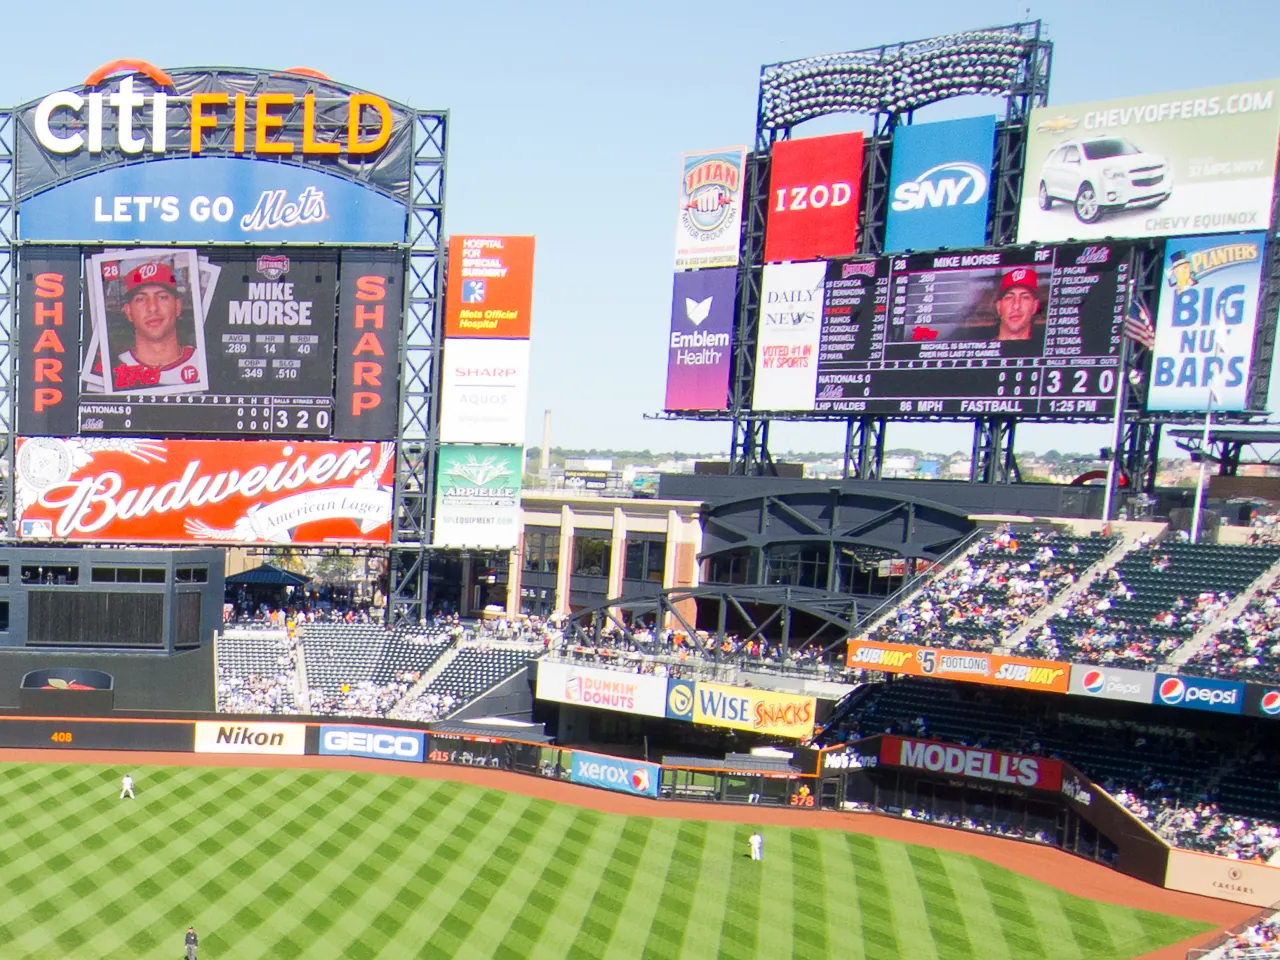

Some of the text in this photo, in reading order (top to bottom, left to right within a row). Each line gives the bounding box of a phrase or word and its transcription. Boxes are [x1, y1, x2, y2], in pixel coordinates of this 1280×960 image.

[1083, 89, 1274, 130] CHEVYOFFERS.COM
[190, 92, 393, 154] FIELD
[687, 164, 736, 189] TITAN
[775, 182, 852, 211] IZOD
[891, 175, 973, 211] SNY
[94, 186, 328, 231] LET'S GO Mets
[1144, 211, 1258, 232] CHEVY EQUINOX
[462, 249, 480, 257] FOR
[463, 239, 504, 249] HOSPITAL
[933, 250, 1051, 268] MIKE MORSE RF
[1191, 245, 1258, 272] PLANTERS
[103, 266, 118, 276] 28
[248, 282, 294, 300] MIKE
[768, 289, 815, 303] DAILY
[228, 301, 313, 325] MORSE
[485, 310, 518, 319] Official
[1171, 284, 1246, 327] BIG
[459, 320, 498, 329] Hospital
[765, 311, 815, 325] NEWS
[33, 272, 65, 411] SHARP
[352, 276, 387, 415] SHARP
[670, 330, 729, 348] Emblem
[1179, 329, 1231, 353] NU
[225, 344, 247, 354] .289
[264, 344, 276, 354] 14
[298, 344, 311, 354] 40
[676, 348, 718, 365] Health
[762, 345, 812, 357] VOTED #1 IN
[763, 356, 808, 369] NY SPORTS
[183, 368, 195, 379] IF
[275, 369, 297, 379] .510
[455, 367, 516, 377] SHARP
[1046, 370, 1113, 393] 3 2 0
[459, 394, 508, 405] AQUOS
[832, 401, 1096, 412] VALDES 86 MPH FASTBALL 1:25 PM
[81, 406, 124, 414] NATIONALS
[276, 410, 329, 428] 3 2 0
[41, 446, 372, 537] Budweiser
[444, 487, 514, 498] ARPIELLE
[266, 497, 384, 530] American Lager
[852, 647, 1063, 685] SUBWAY $5 FOOTLONG SUBWAY
[585, 680, 638, 696] DUNKIN'
[1107, 682, 1140, 694] pepsi
[1186, 687, 1238, 705] pepsi
[583, 691, 634, 709] DONUTS
[699, 689, 811, 728] WISE SNACKS
[51, 732, 72, 742] 408
[216, 726, 284, 746] Nikon
[324, 730, 419, 757] GEICO
[429, 750, 449, 762] 415
[900, 740, 1039, 787] MODELL'S
[578, 760, 629, 785] xerox
[790, 794, 814, 807] 378
[1212, 881, 1254, 894] CAESARS
